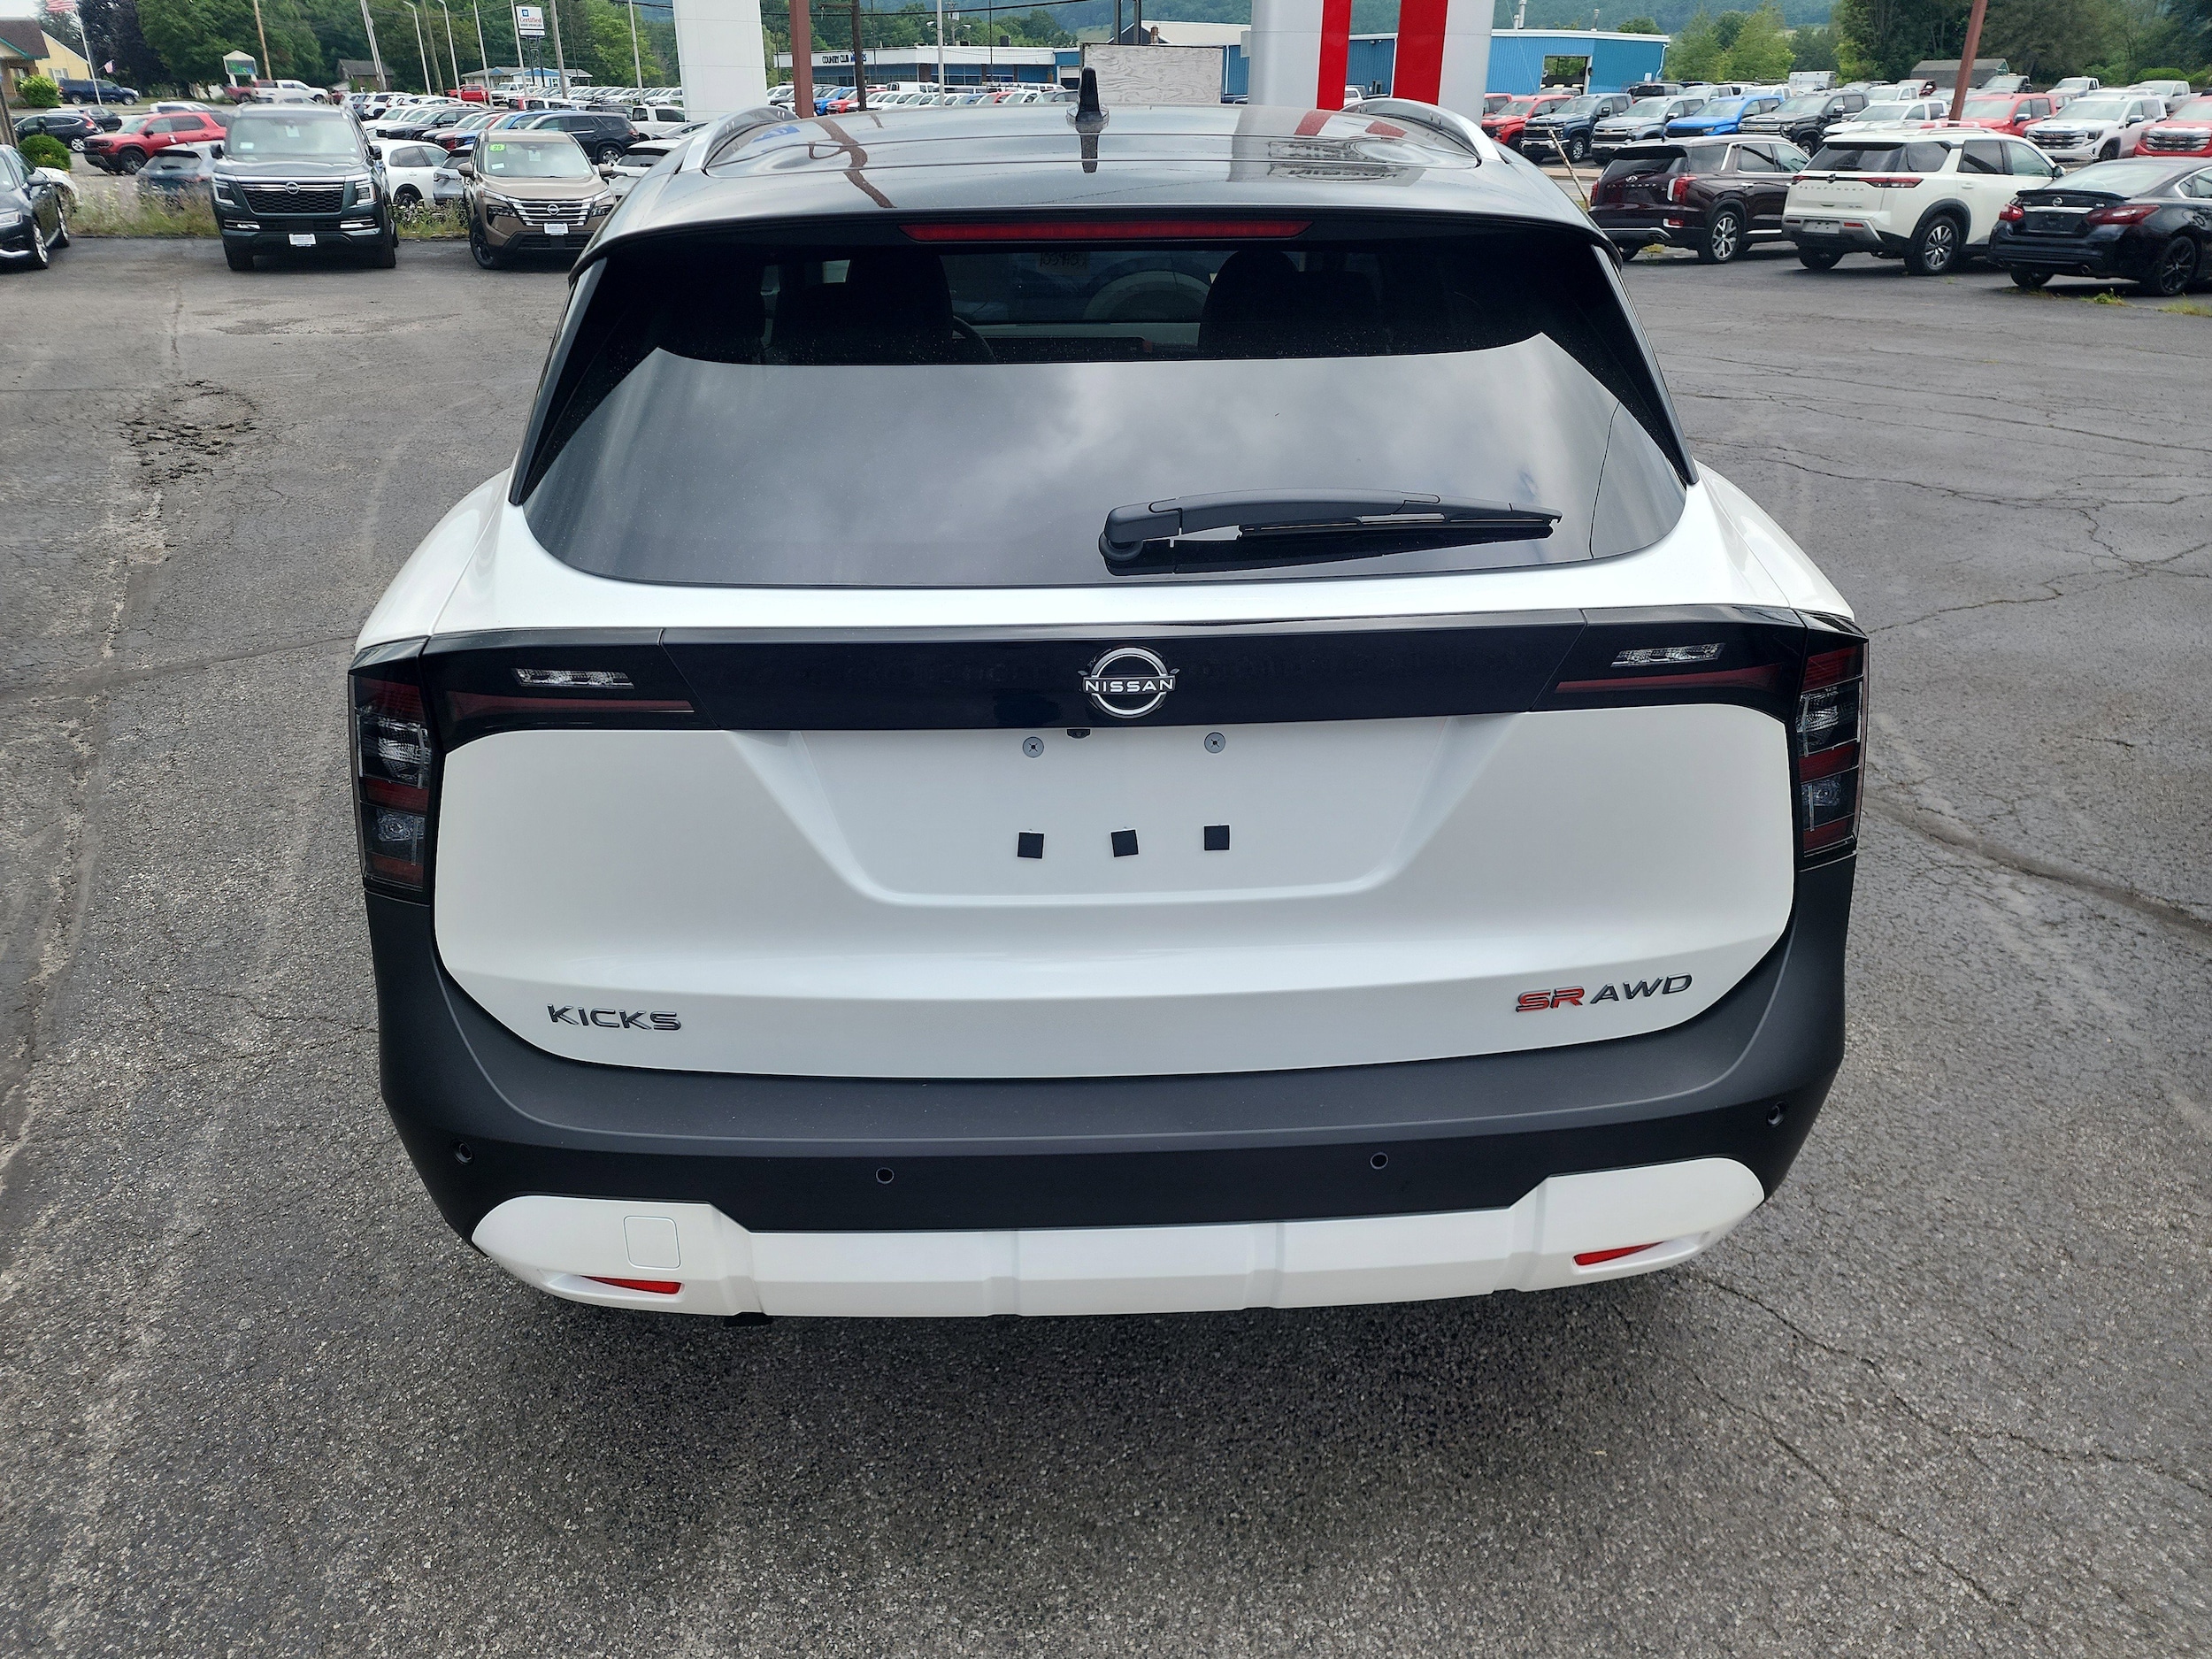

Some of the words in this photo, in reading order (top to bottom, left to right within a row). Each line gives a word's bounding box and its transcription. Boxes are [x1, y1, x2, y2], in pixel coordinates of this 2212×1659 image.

[1085, 678, 1173, 693] NISSAN
[1516, 985, 1585, 1012] SR
[1589, 972, 1693, 1004] AWD
[547, 1003, 681, 1031] KICKS
